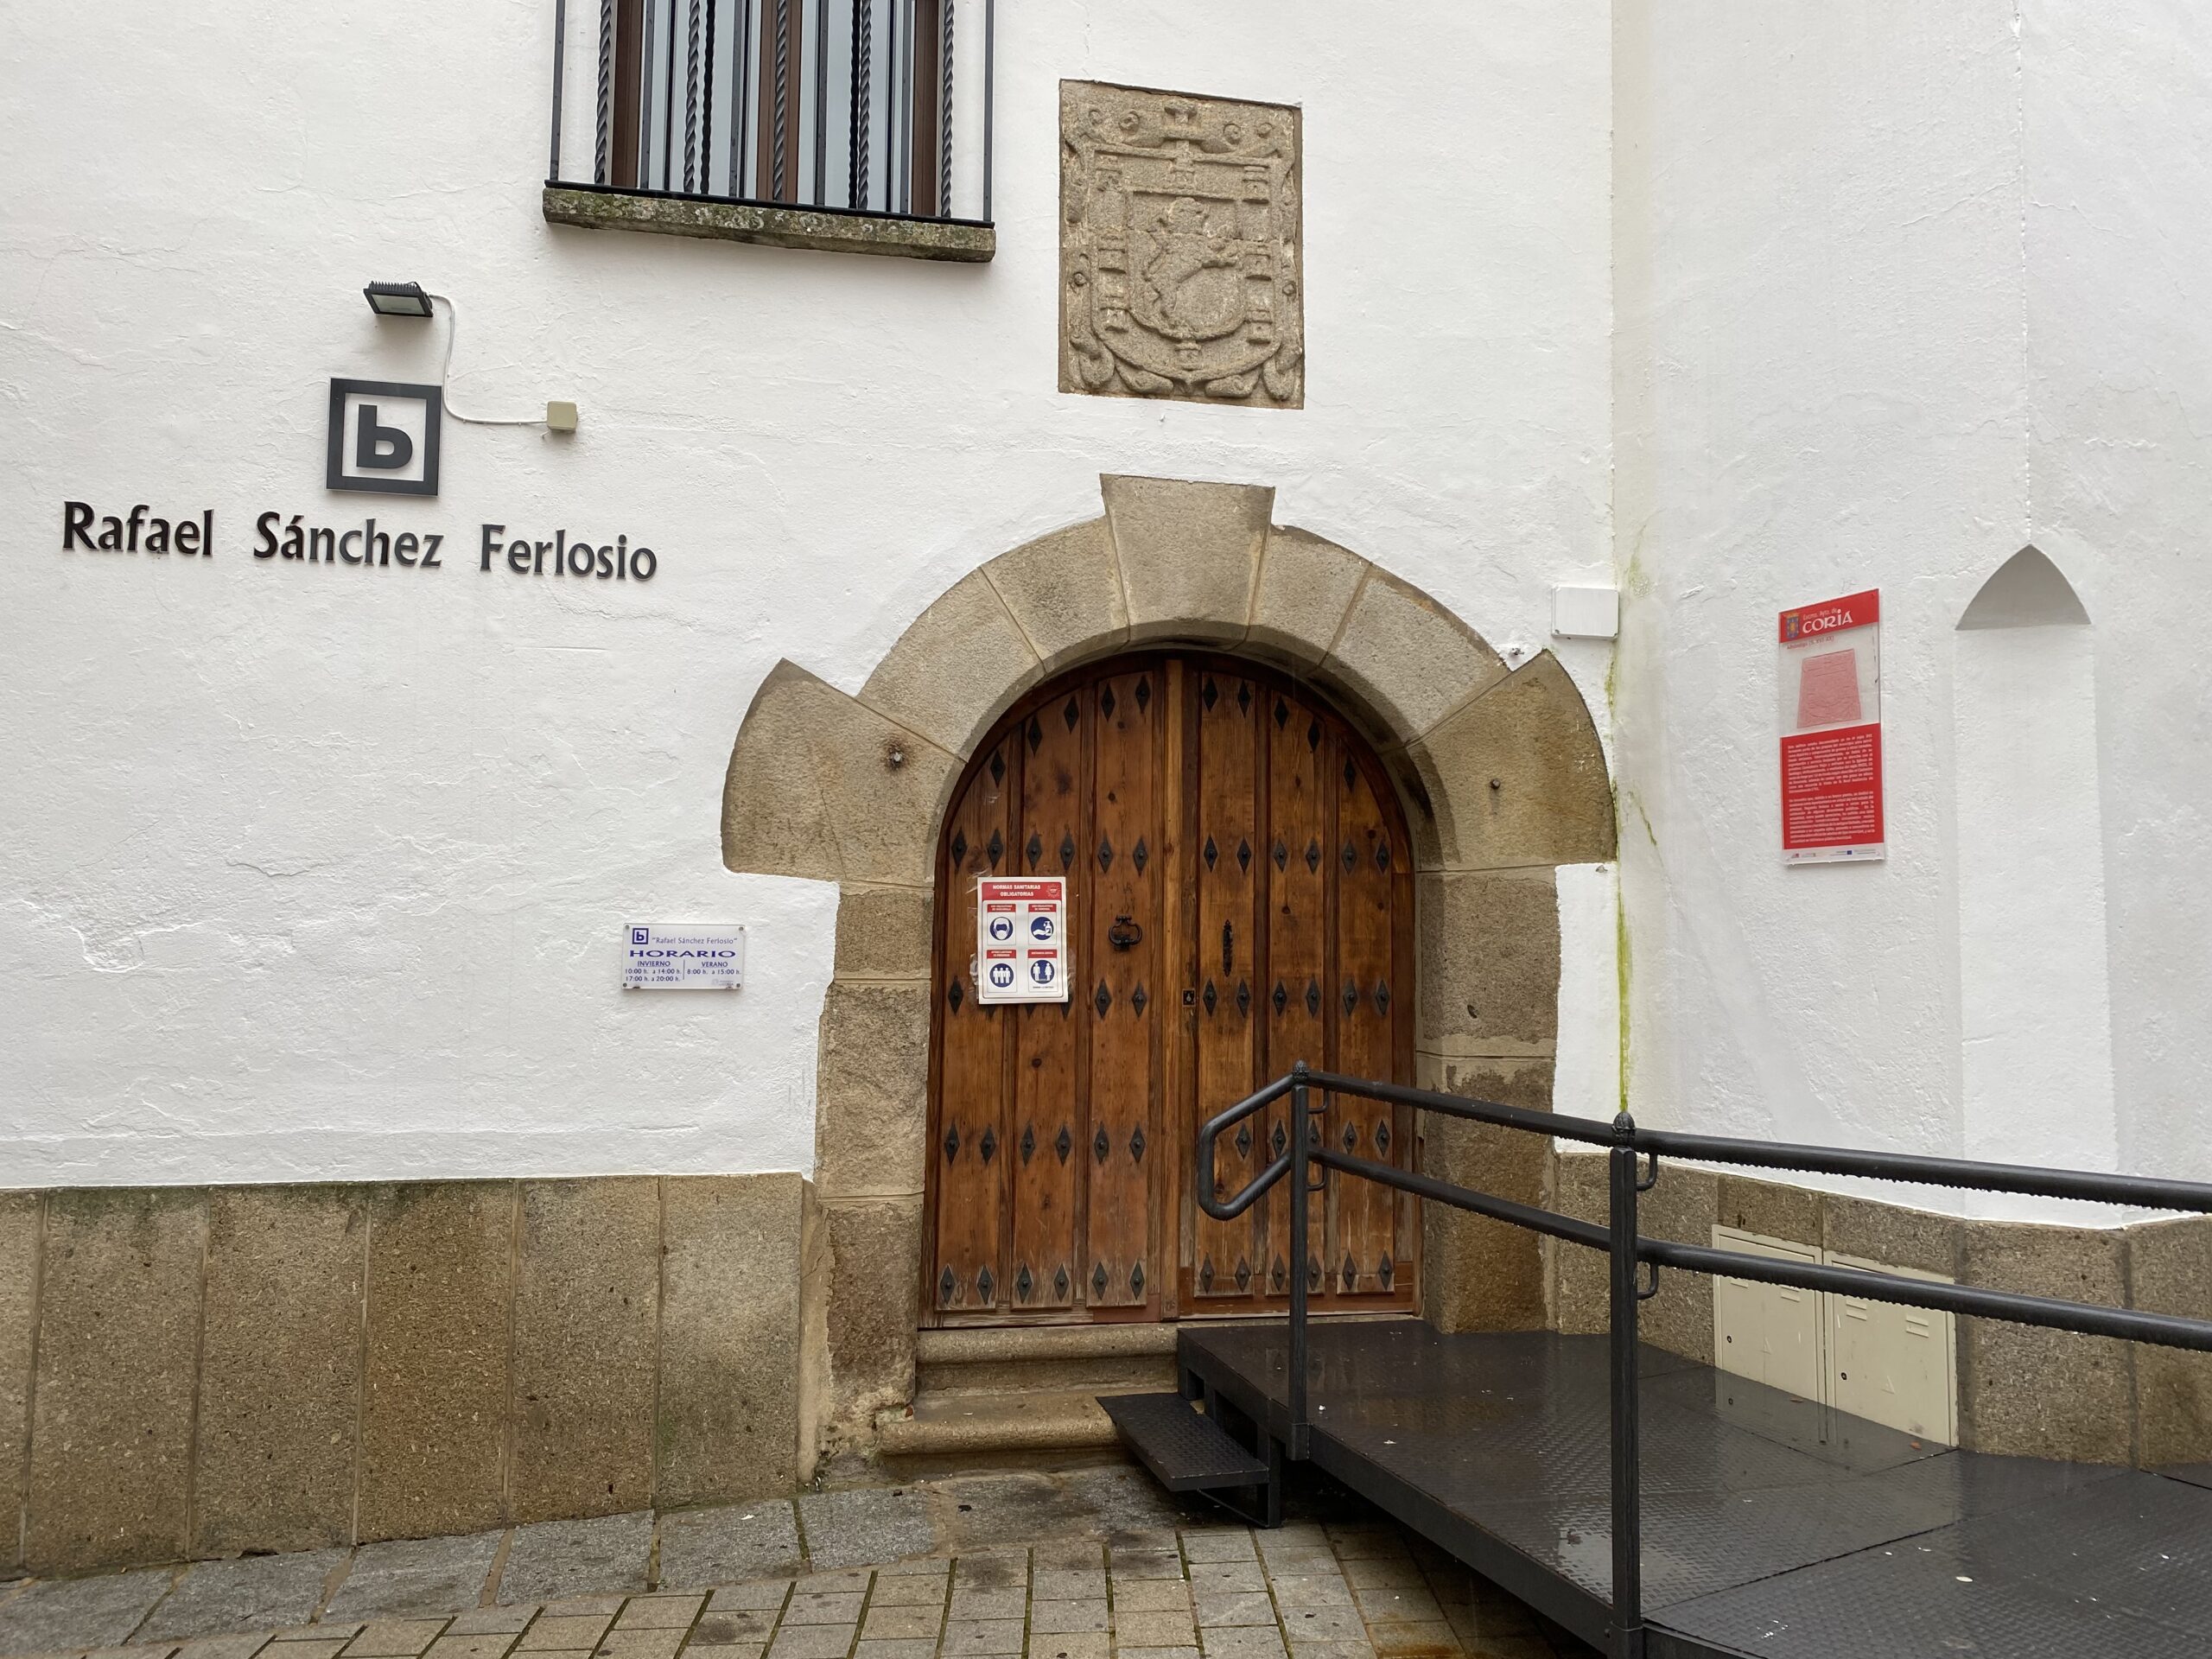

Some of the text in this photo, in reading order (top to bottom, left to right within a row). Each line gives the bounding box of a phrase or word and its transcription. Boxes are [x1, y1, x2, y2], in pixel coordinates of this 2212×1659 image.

[62, 501, 658, 582] Rafael Sánchez Ferlosio
